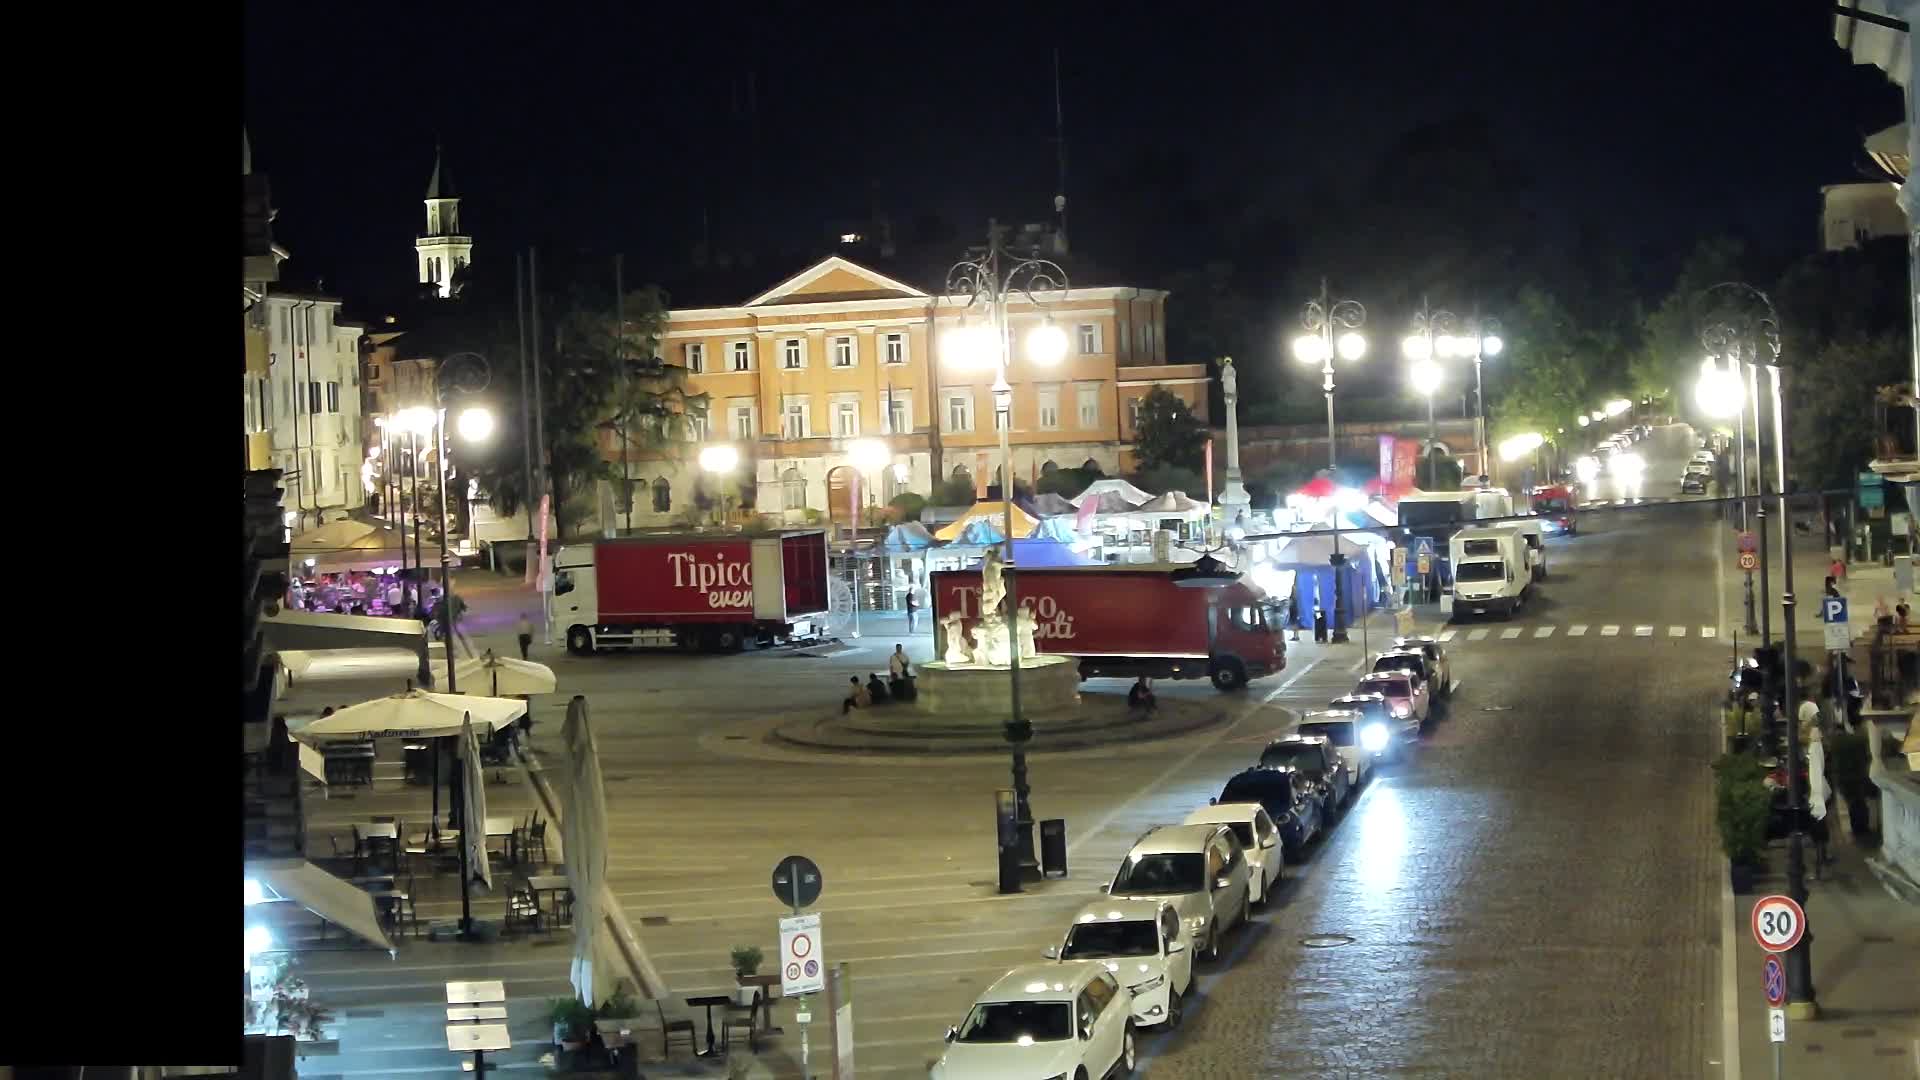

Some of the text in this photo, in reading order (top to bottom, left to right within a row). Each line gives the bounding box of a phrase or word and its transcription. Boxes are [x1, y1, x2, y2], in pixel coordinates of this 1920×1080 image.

[1743, 556, 1753, 566] 20
[1827, 601, 1842, 621] P
[1762, 910, 1791, 936] 30
